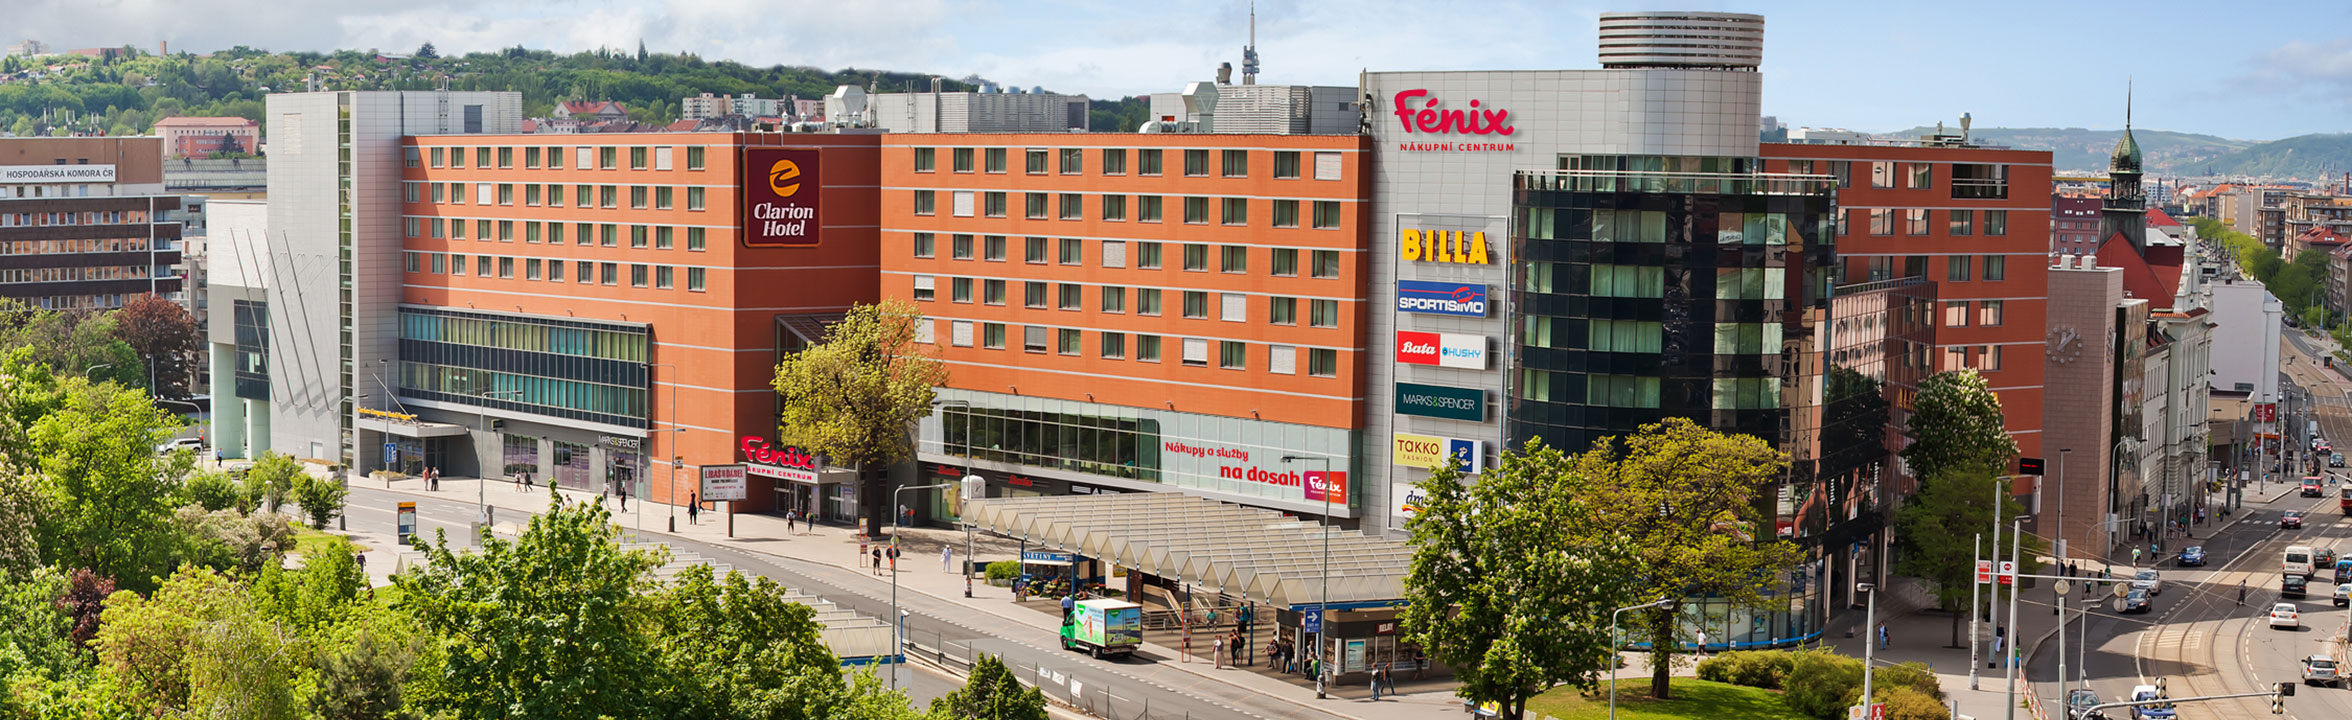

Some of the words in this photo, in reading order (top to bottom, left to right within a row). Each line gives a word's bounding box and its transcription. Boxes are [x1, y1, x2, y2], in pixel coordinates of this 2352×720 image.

[1394, 89, 1515, 136] Fénix
[1400, 141, 1453, 152] NÁKUPNÍ
[1458, 143, 1515, 152] CENTRUM
[6, 168, 65, 179] HOSPODÁŘSKÁ
[67, 169, 101, 178] KOMORA
[102, 168, 114, 178] ČR
[754, 202, 814, 219] Clarion
[763, 220, 806, 236] Hotel
[1402, 228, 1490, 264] BILLA
[1402, 341, 1437, 355] Bata
[1448, 346, 1482, 359] HUSKY
[1403, 393, 1475, 410] MARKS&SPENCER
[741, 436, 815, 469] Fénix
[1165, 441, 1205, 458] Nákupy
[1207, 447, 1214, 456] a
[1216, 446, 1249, 462] služby
[1403, 454, 1433, 463] FASHION
[747, 465, 775, 476] ÁKUPNÍ
[778, 470, 812, 481] CENTRUM
[1220, 465, 1243, 480] na
[1246, 465, 1300, 487] dosah
